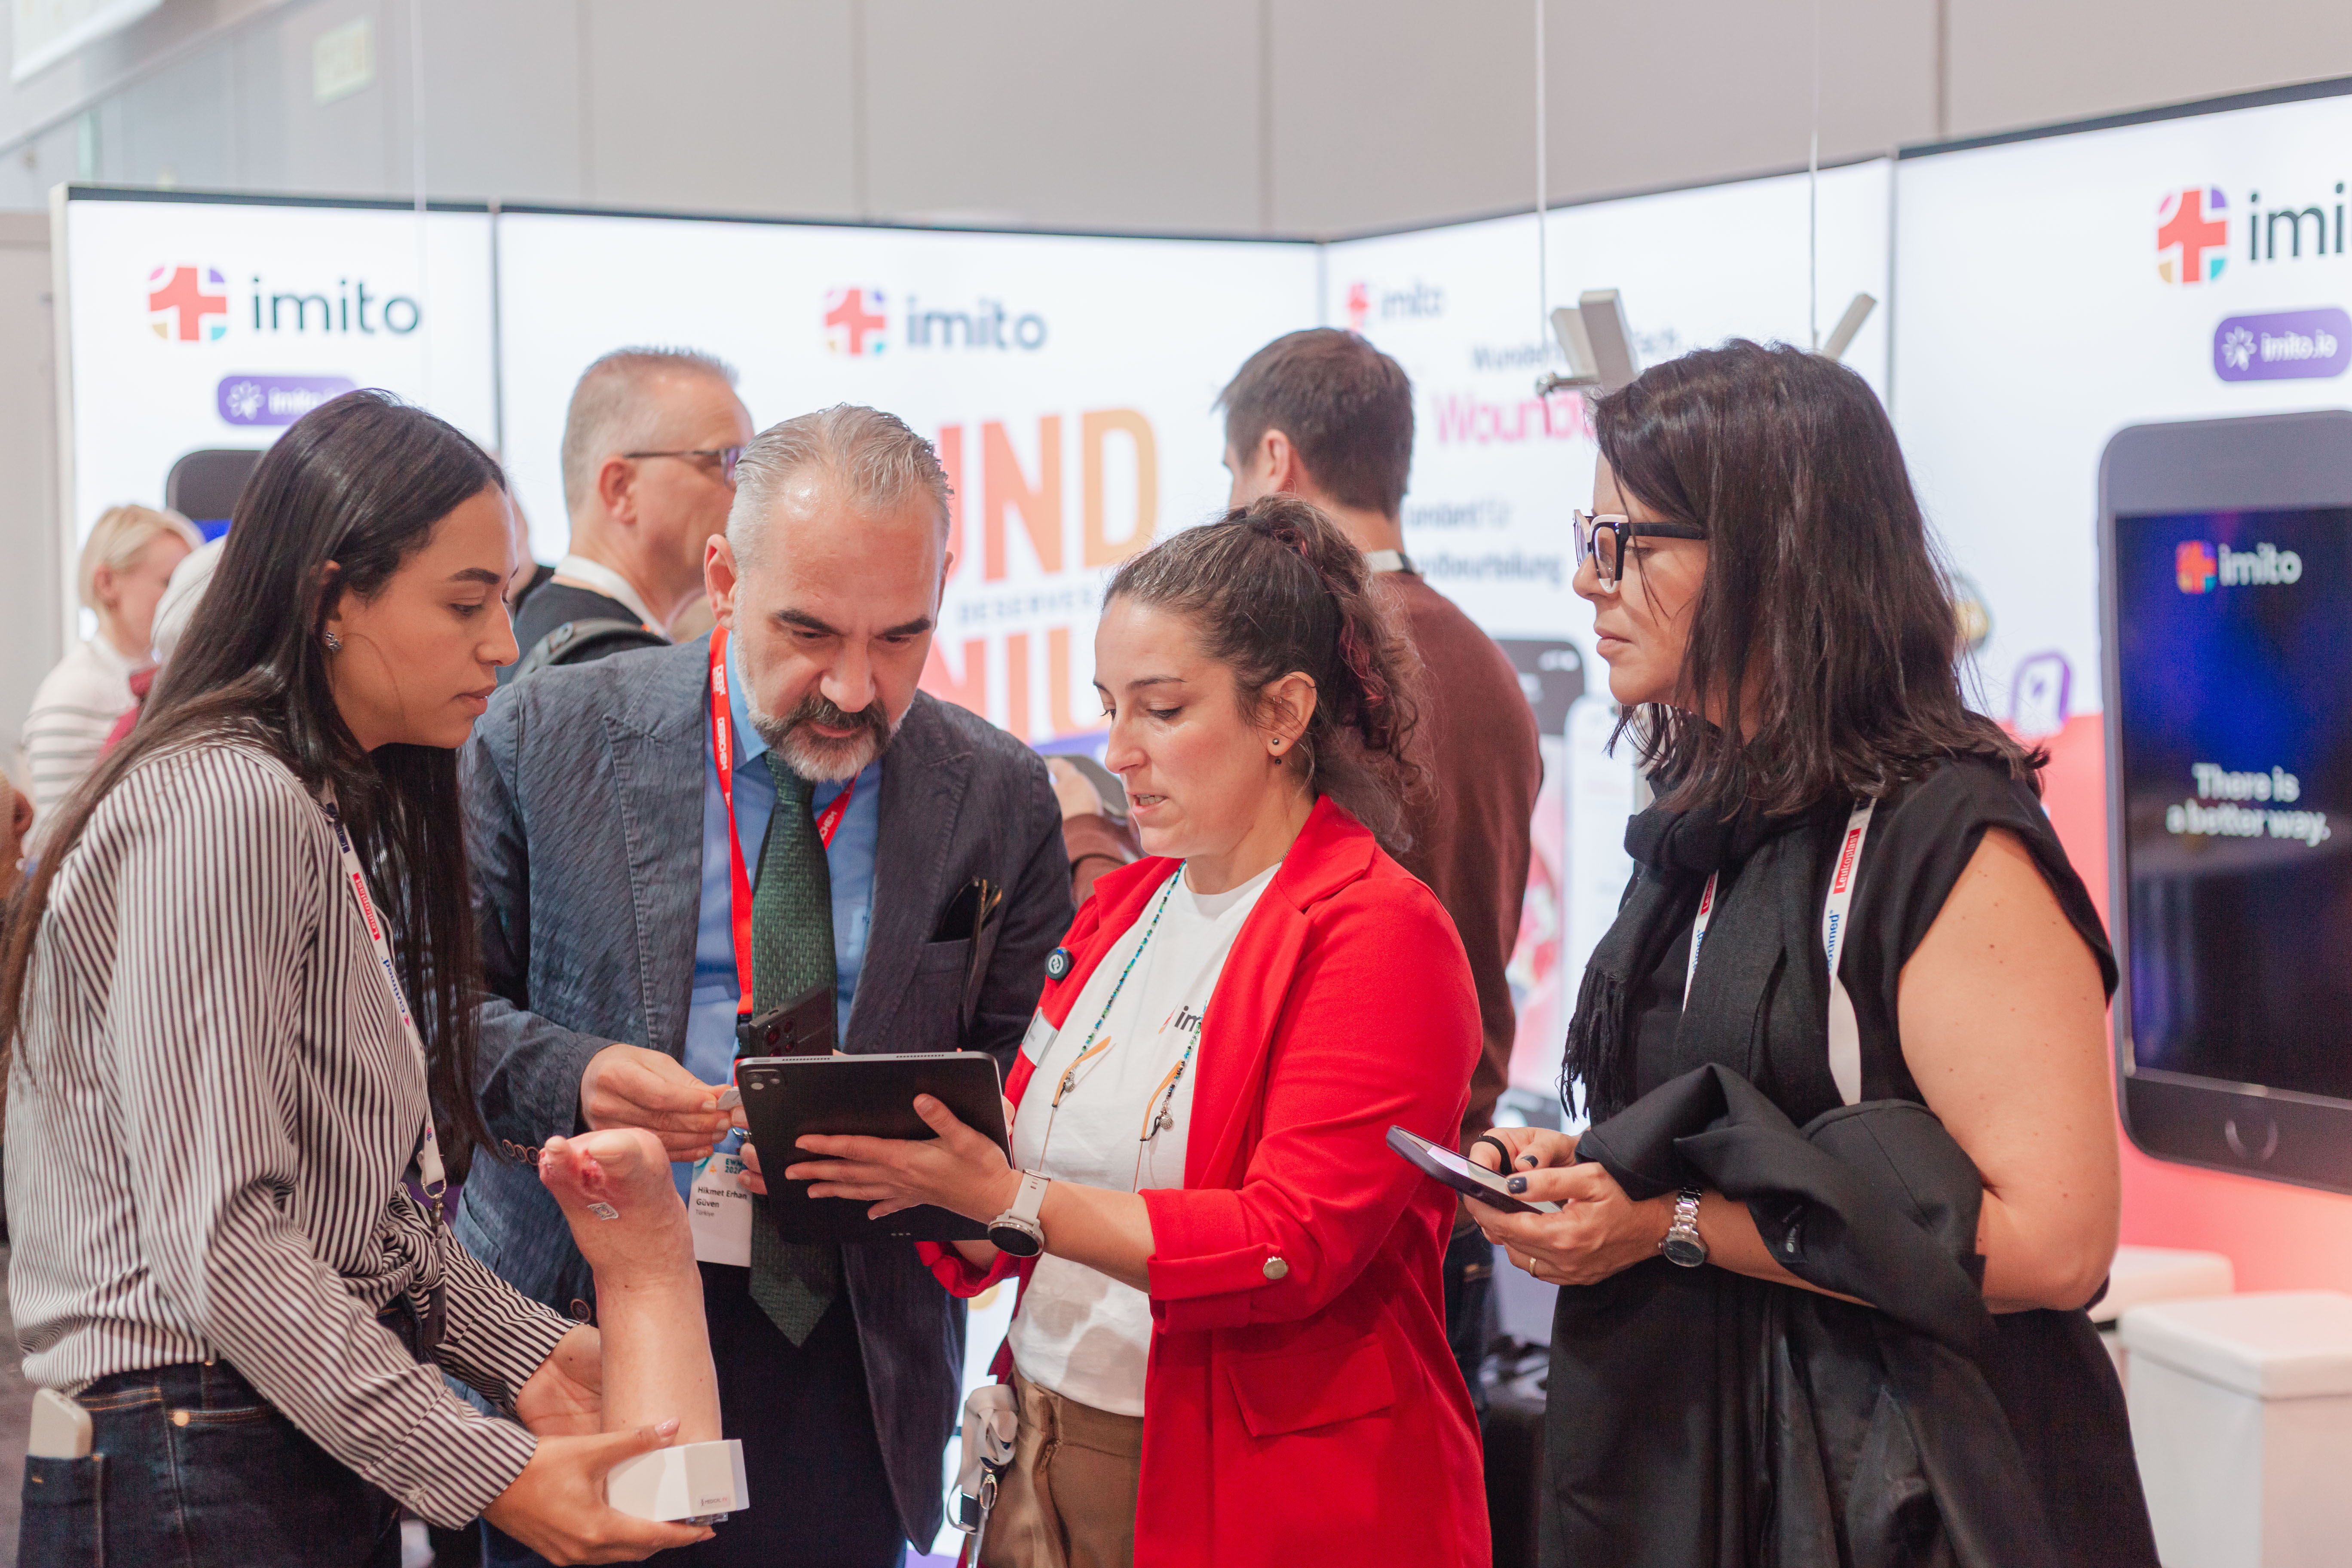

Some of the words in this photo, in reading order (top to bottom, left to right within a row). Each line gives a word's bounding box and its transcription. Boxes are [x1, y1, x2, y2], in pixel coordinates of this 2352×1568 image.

[2251, 183, 2345, 260] imi
[253, 276, 420, 334] imito
[907, 295, 1047, 350] imito
[2218, 542, 2303, 586] imito
[2192, 762, 2272, 802] There
[2272, 766, 2300, 802] is
[2166, 805, 2184, 834] a
[2185, 798, 2265, 838] better
[2266, 809, 2331, 847] way.
[1836, 833, 1859, 889] Leukoplast
[355, 879, 378, 936] Leukoplast
[696, 1198, 720, 1208] Güven
[698, 1186, 725, 1196] Hikmet
[726, 1190, 747, 1199] Erhan
